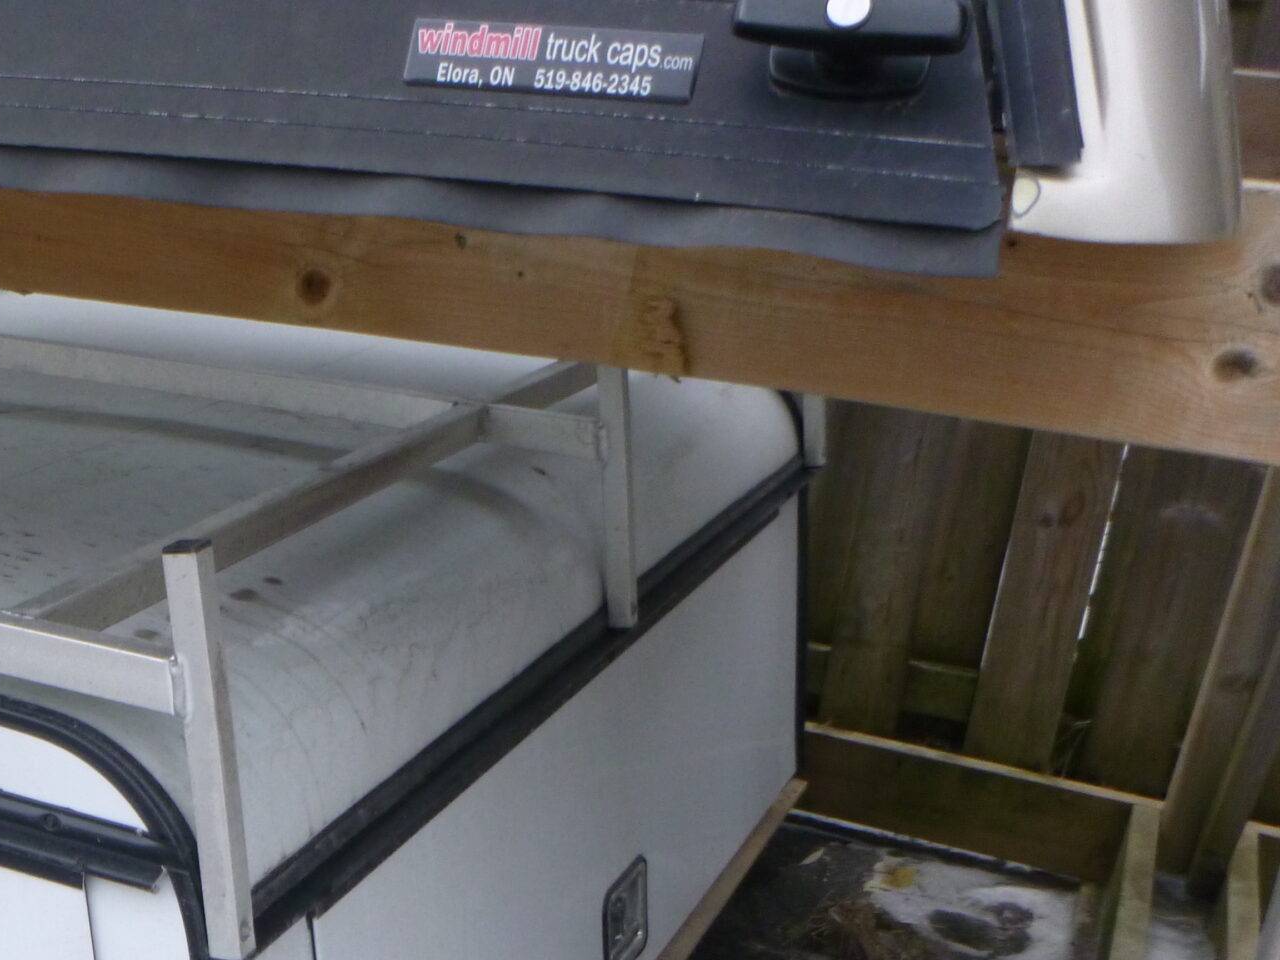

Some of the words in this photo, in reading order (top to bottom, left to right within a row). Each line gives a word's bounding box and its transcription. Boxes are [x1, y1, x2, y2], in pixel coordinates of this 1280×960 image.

[418, 22, 542, 61] windmill
[546, 32, 600, 63] truck
[436, 62, 483, 88] Elora,
[489, 67, 515, 86] ON
[533, 67, 652, 96] 519-846-2345
